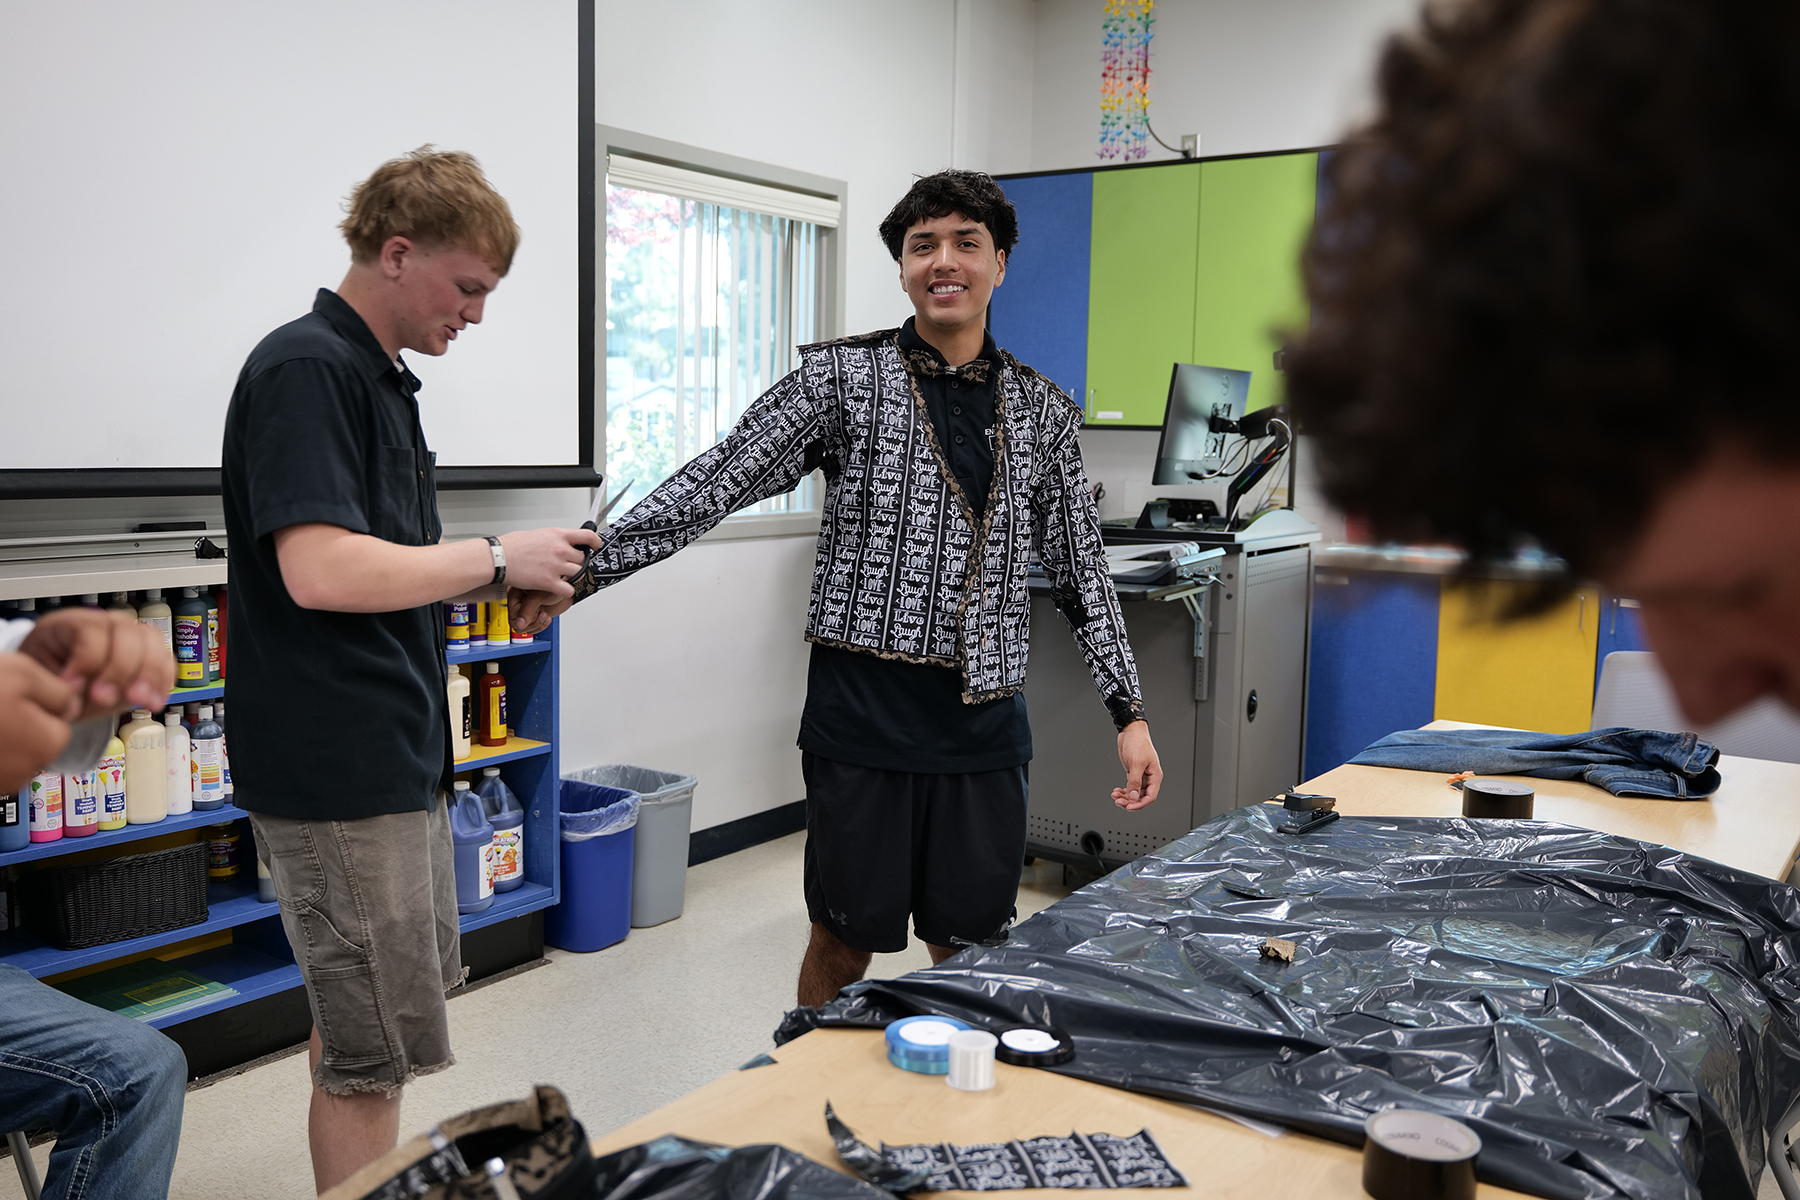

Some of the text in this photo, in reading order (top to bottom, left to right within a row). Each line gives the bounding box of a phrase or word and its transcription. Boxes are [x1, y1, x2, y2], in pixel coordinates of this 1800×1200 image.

[844, 386, 872, 398] Live
[886, 380, 905, 392] LOVE
[882, 387, 909, 405] Live
[791, 394, 815, 417] LOVE
[844, 398, 871, 413] Laugh
[879, 400, 909, 415] Laugh
[783, 401, 805, 429] Live
[884, 413, 904, 427] LOVE
[770, 428, 789, 446] OVE
[878, 426, 907, 441] Live
[757, 434, 779, 458] Live
[874, 438, 905, 455] Laugh
[747, 443, 771, 469] Laugh
[878, 453, 900, 468] LOVE
[739, 453, 760, 476] LOVE
[911, 458, 938, 475] Laug
[726, 461, 750, 488] Live
[872, 466, 903, 481] Live
[914, 473, 937, 488] LOVE
[717, 471, 743, 498] Laugh
[869, 480, 901, 496] Laugh
[873, 494, 895, 508] LOVE
[910, 486, 939, 501] Live
[838, 506, 862, 519] Live
[870, 508, 897, 522] Live
[907, 498, 939, 517] Laugh
[837, 519, 861, 535] Laugh
[911, 513, 932, 528] LOVE
[950, 518, 972, 531] LOV
[868, 521, 896, 537] Laugh
[905, 526, 935, 542] Live
[840, 534, 858, 547] LOVE
[868, 536, 888, 550] LOVE
[902, 540, 934, 557] Laugh
[620, 540, 637, 567] LOVE
[632, 536, 649, 566] Laugh
[835, 546, 857, 560] Live
[863, 549, 891, 564] Live
[942, 544, 968, 560] Laug
[832, 559, 853, 575] Laugh
[905, 554, 928, 570] LOVE
[860, 562, 890, 579] Laugh
[900, 567, 930, 583] Live
[830, 573, 848, 587] LOVE
[863, 578, 883, 591] LOVE
[941, 573, 962, 586] Liv
[1078, 577, 1102, 594] Laugh
[825, 586, 849, 600] Live
[896, 581, 929, 598] Laugh
[937, 585, 962, 602] Laug
[856, 590, 885, 606] Live
[899, 595, 922, 611] LOVE
[940, 598, 959, 613] LOV
[822, 598, 847, 616] Laugh
[853, 603, 884, 621] Laugh
[1087, 605, 1108, 617] ive
[822, 614, 840, 628] LOVE
[855, 618, 877, 633] LOVE
[894, 610, 925, 625] Live
[935, 613, 957, 627] Liv
[851, 632, 880, 647] Live
[890, 623, 923, 640] Laugh
[932, 625, 957, 644] Laug
[1089, 629, 1112, 644] LOVE
[893, 638, 916, 654] LOVE
